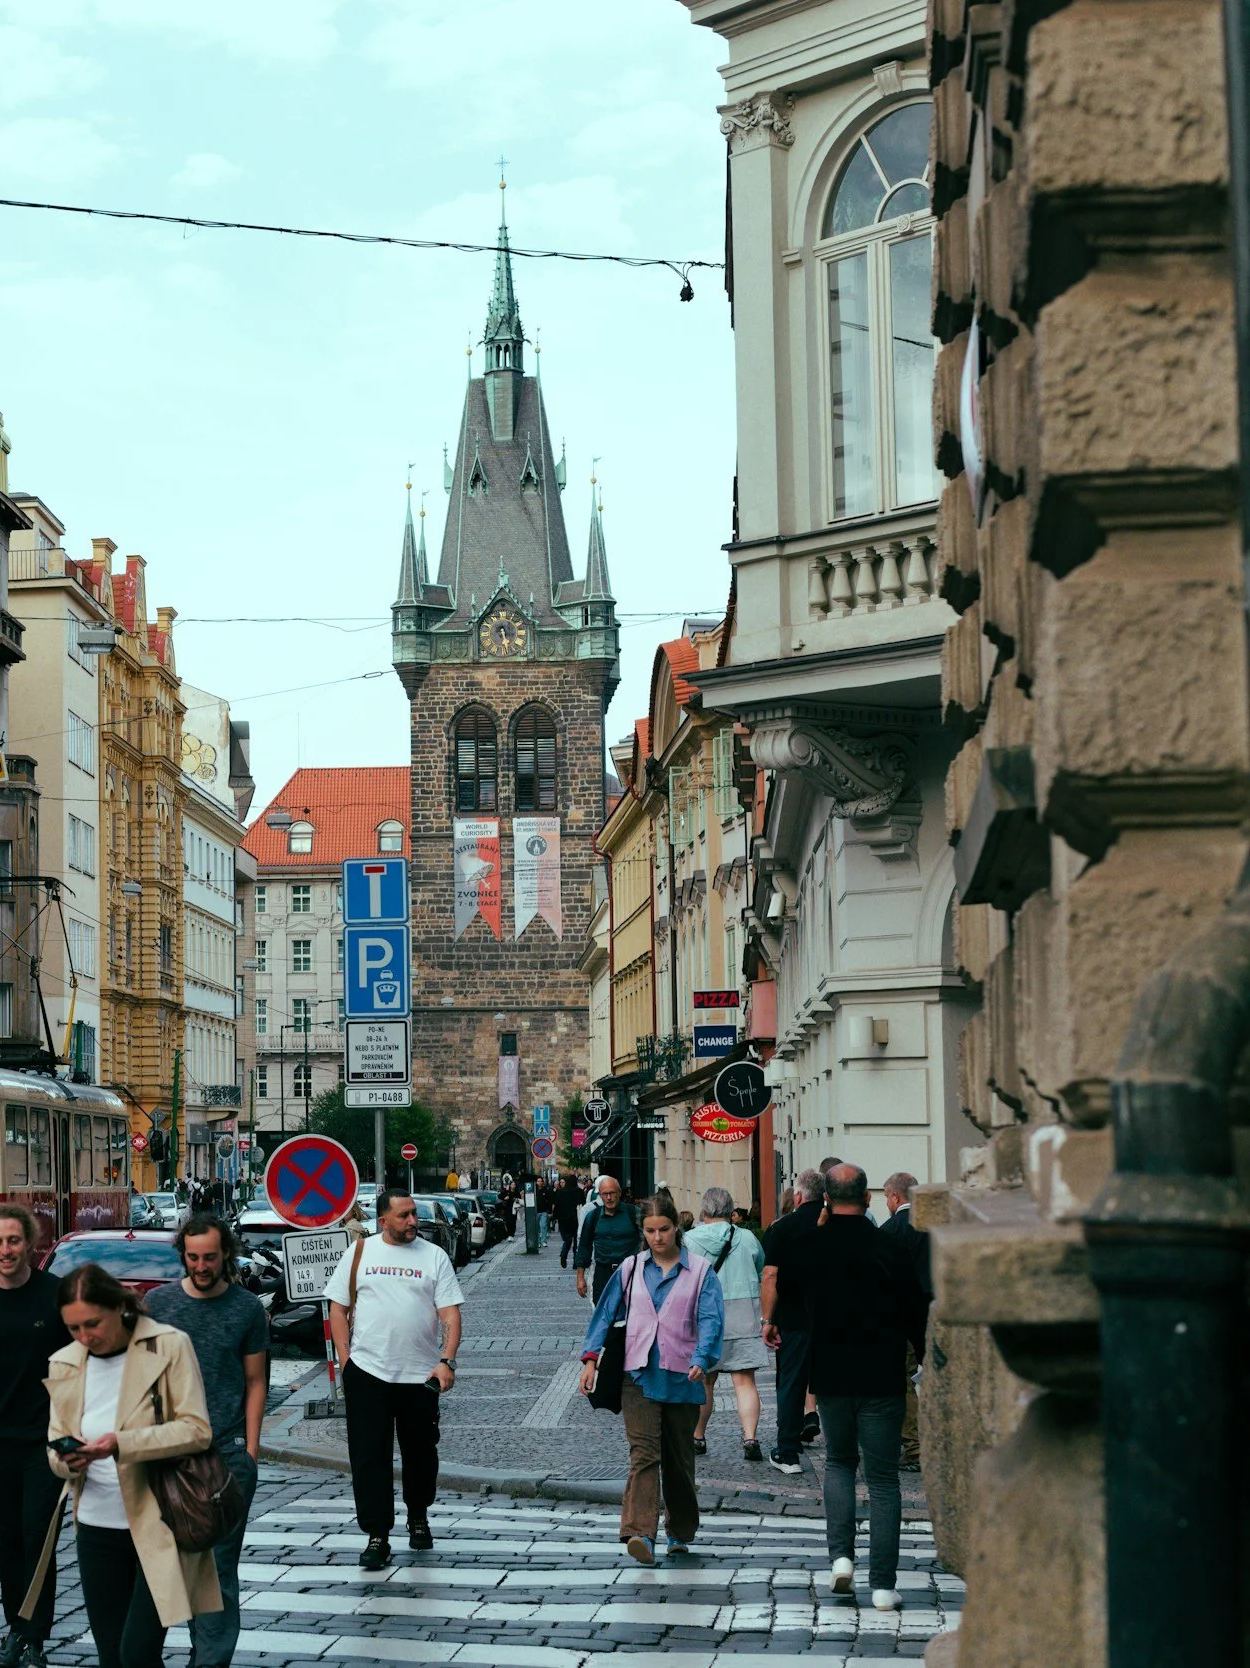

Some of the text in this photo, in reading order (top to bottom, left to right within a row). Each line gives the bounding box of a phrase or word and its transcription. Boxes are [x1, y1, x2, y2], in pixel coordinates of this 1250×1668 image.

[455, 843, 499, 856] RESTAURANT
[457, 890, 499, 898] ZVONICE
[358, 938, 394, 988] P
[694, 993, 739, 1007] PIZZA
[355, 1043, 400, 1052] NEBO S PLATNÝM
[698, 1037, 734, 1047] CHANGE
[361, 1053, 393, 1061] PARKOVACÍM
[368, 1092, 403, 1102] P1-0488
[694, 1104, 723, 1121] RISTO
[703, 1130, 745, 1142] PIZZERIA
[301, 1236, 333, 1251] ČIŠTĚNÍ
[297, 1282, 315, 1293] 8.00
